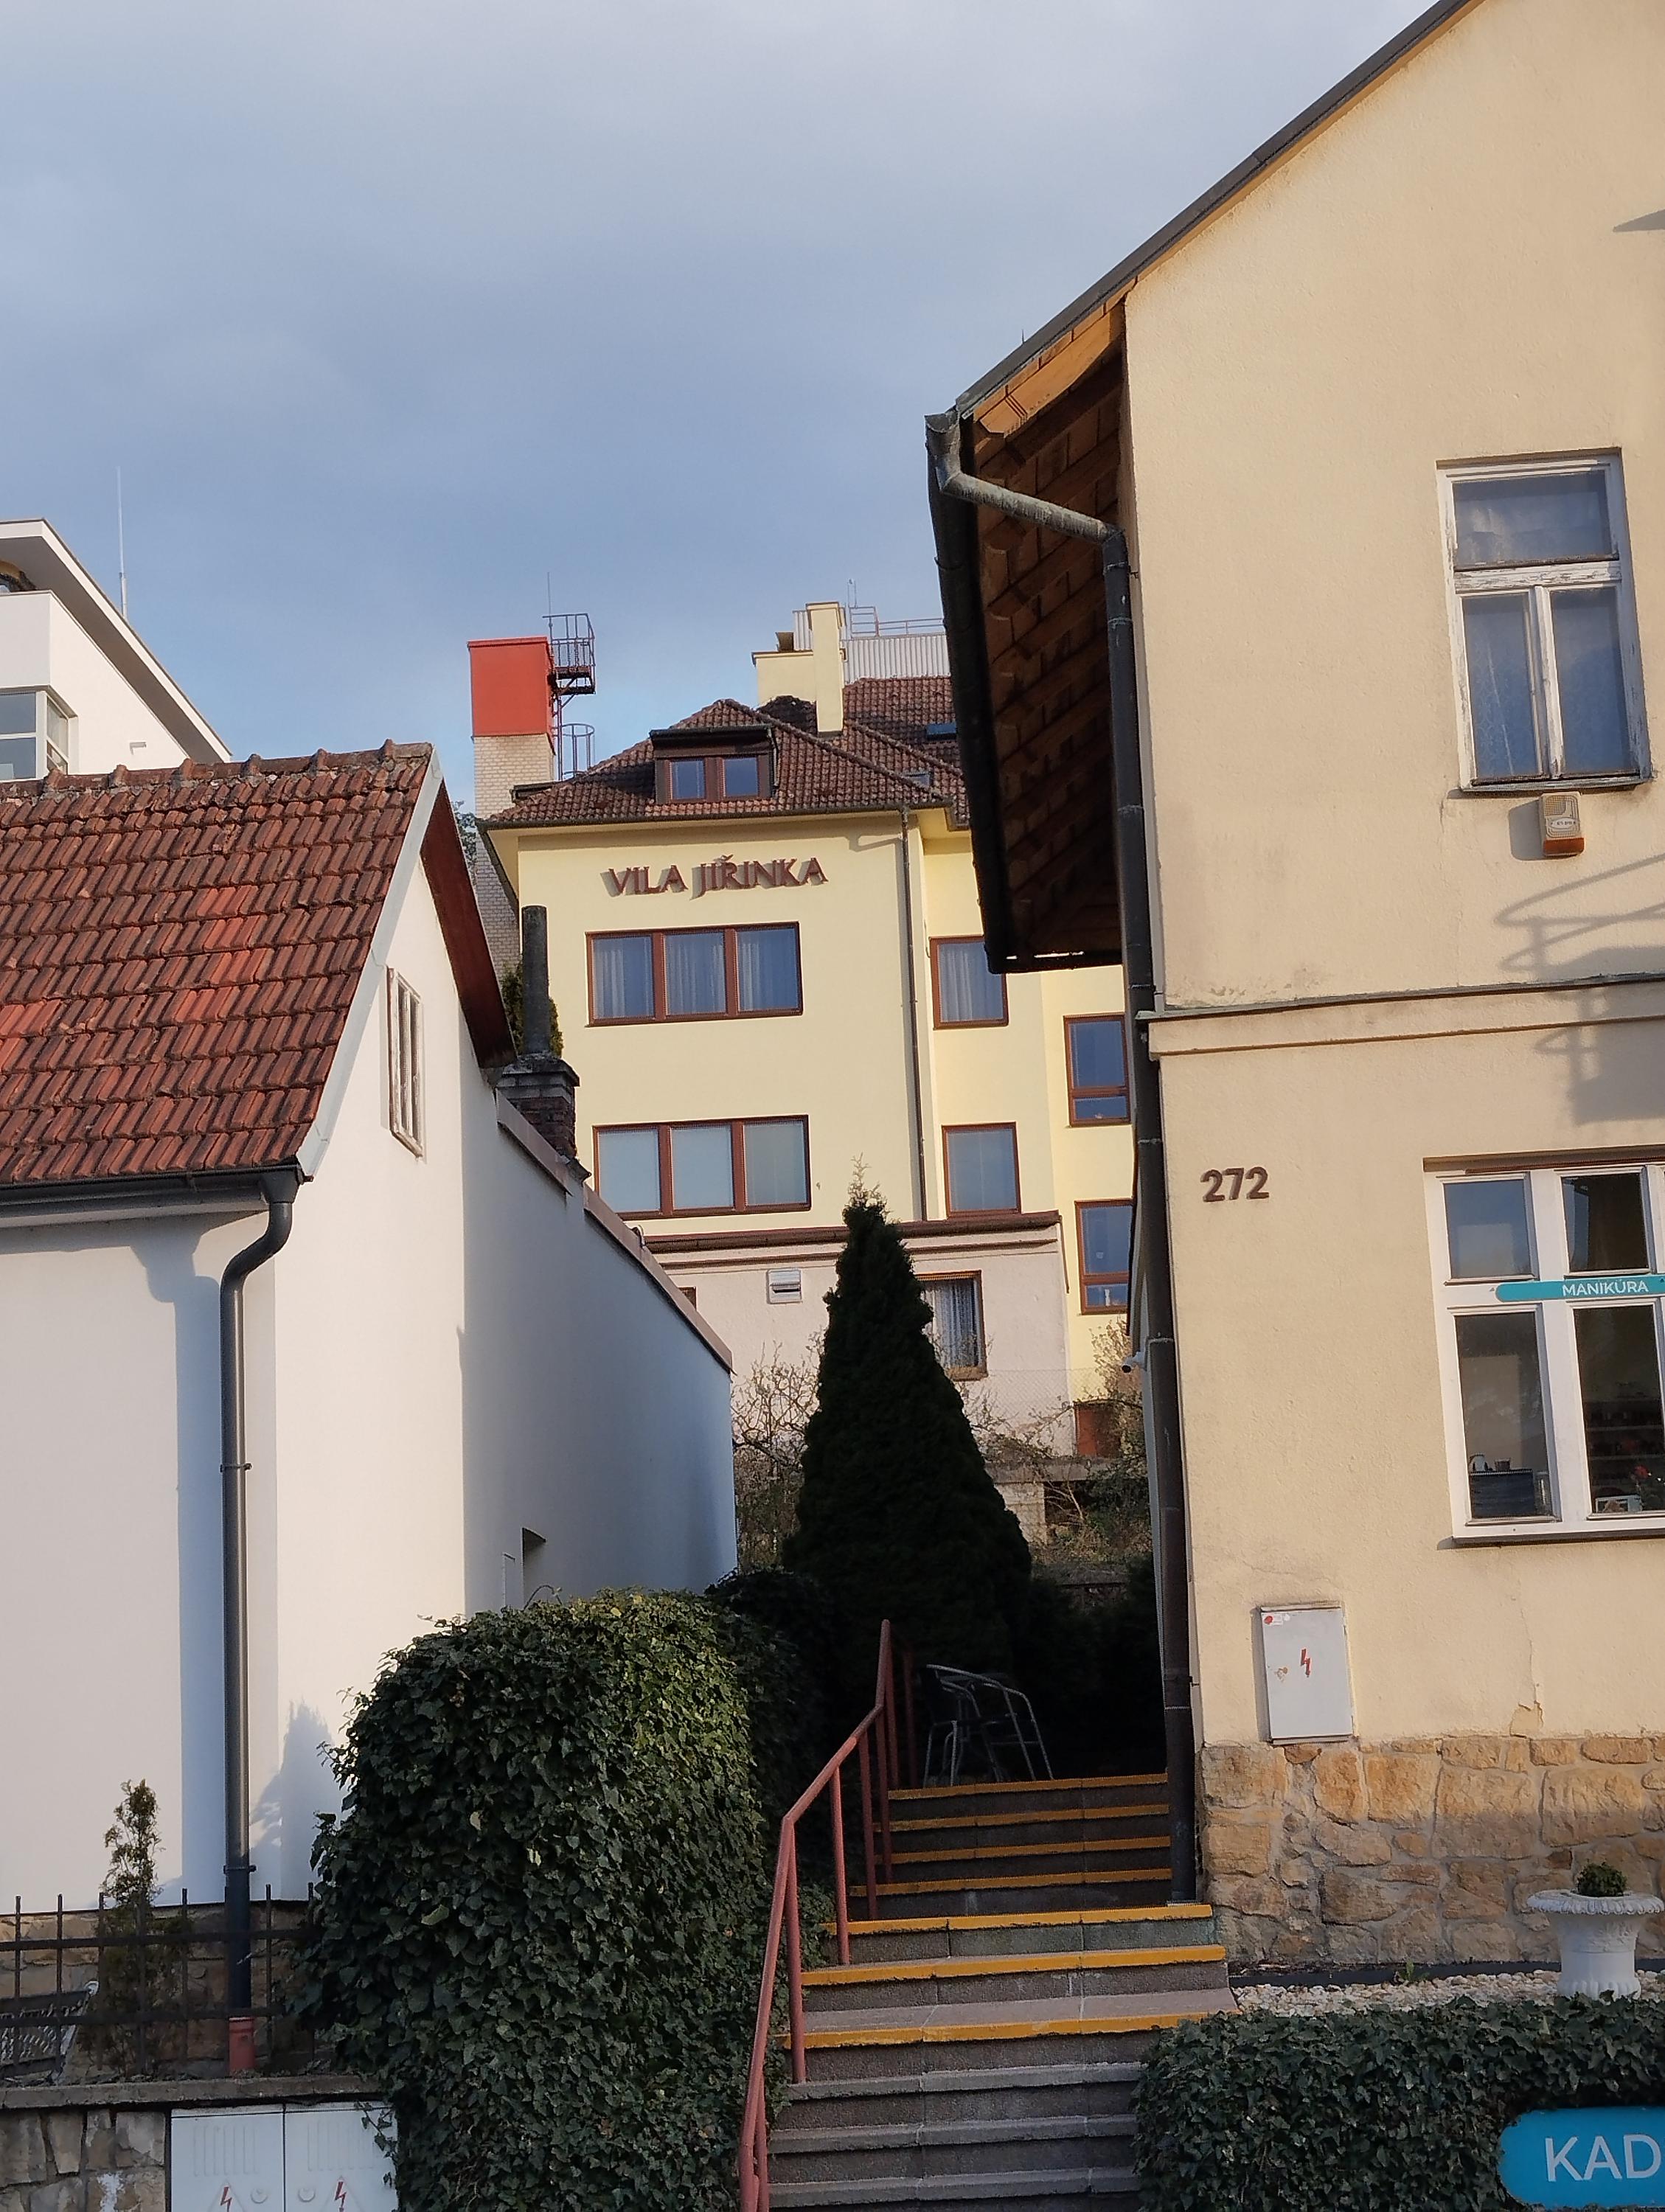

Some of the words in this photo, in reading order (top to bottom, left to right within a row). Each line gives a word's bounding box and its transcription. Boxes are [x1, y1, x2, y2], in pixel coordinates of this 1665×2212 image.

[607, 865, 689, 894] VILA
[694, 854, 829, 900] JIŘINKA
[1200, 1166, 1270, 1202] 272
[1545, 2134, 1661, 2182] KAD
